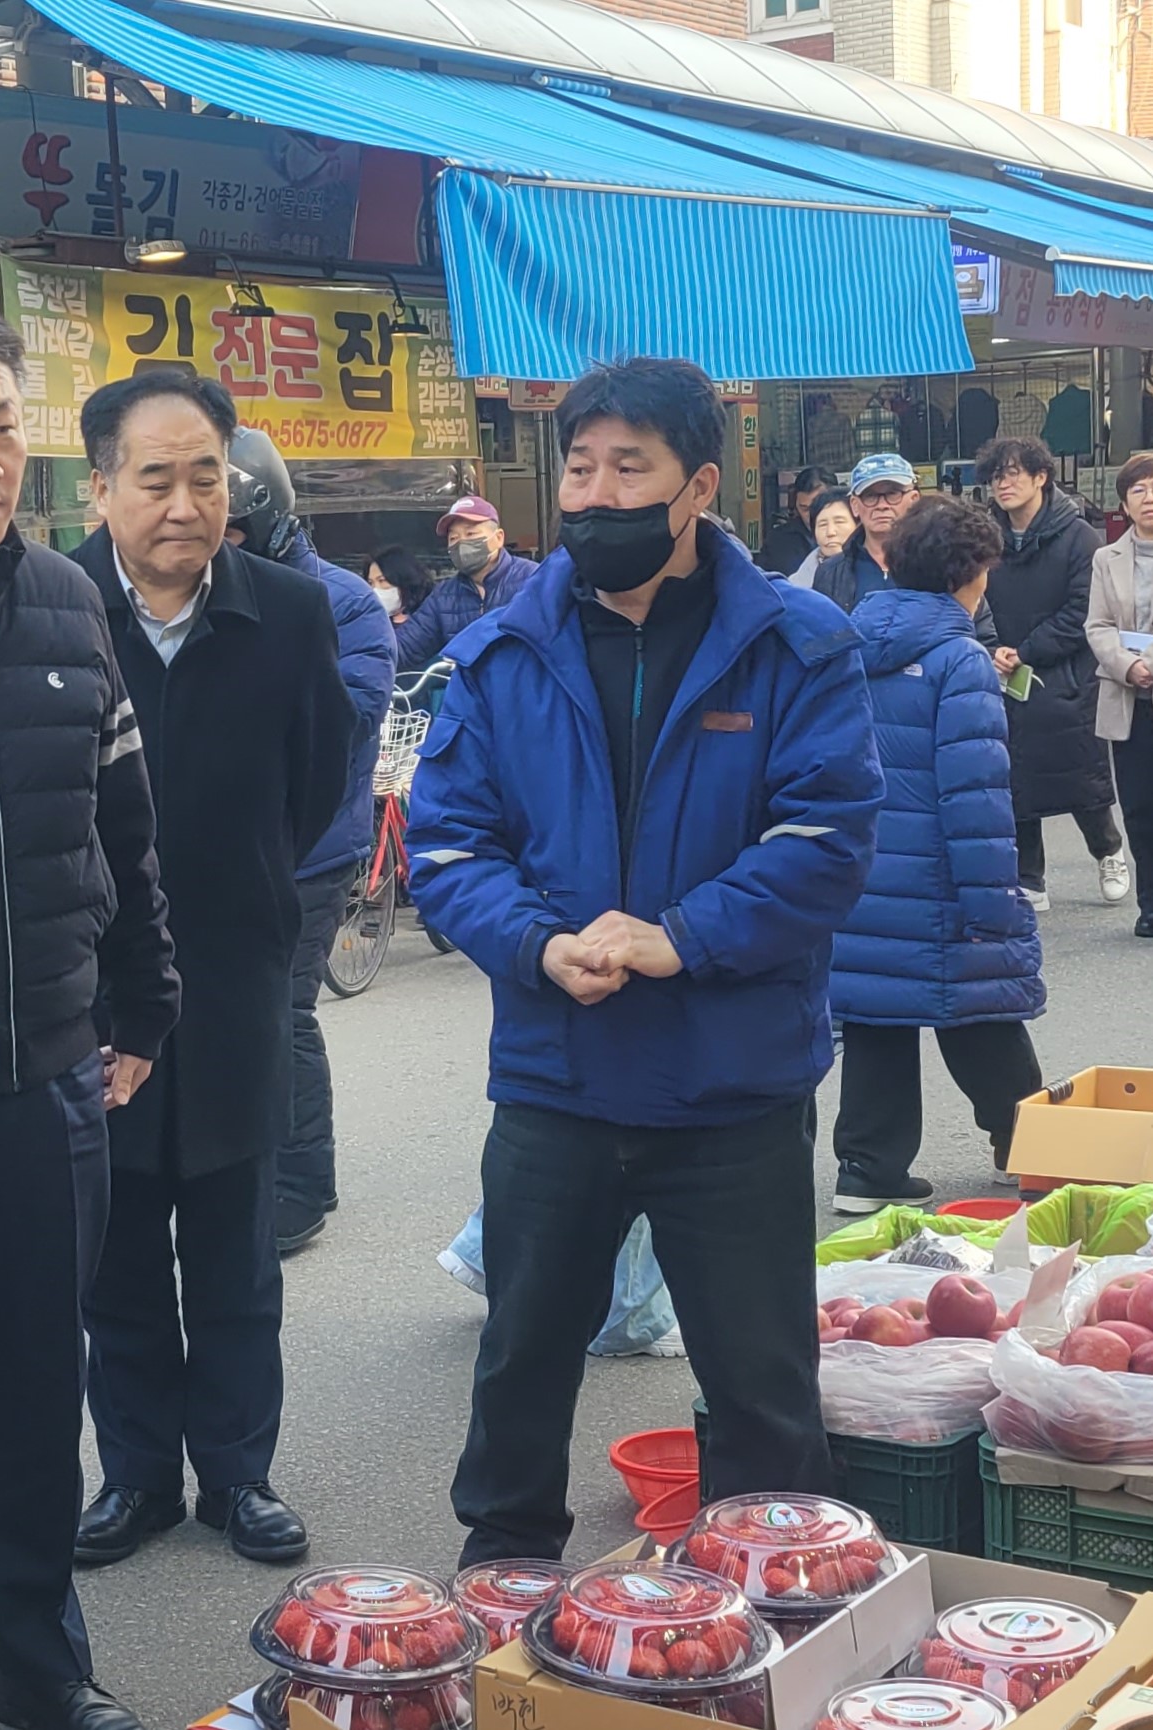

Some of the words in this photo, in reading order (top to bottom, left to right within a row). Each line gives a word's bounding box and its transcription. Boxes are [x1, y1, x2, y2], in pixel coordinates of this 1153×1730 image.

[16, 270, 88, 317] 곱창김
[20, 315, 95, 360] 파래김
[418, 382, 466, 414] 김부각
[420, 417, 469, 449] 고추부각
